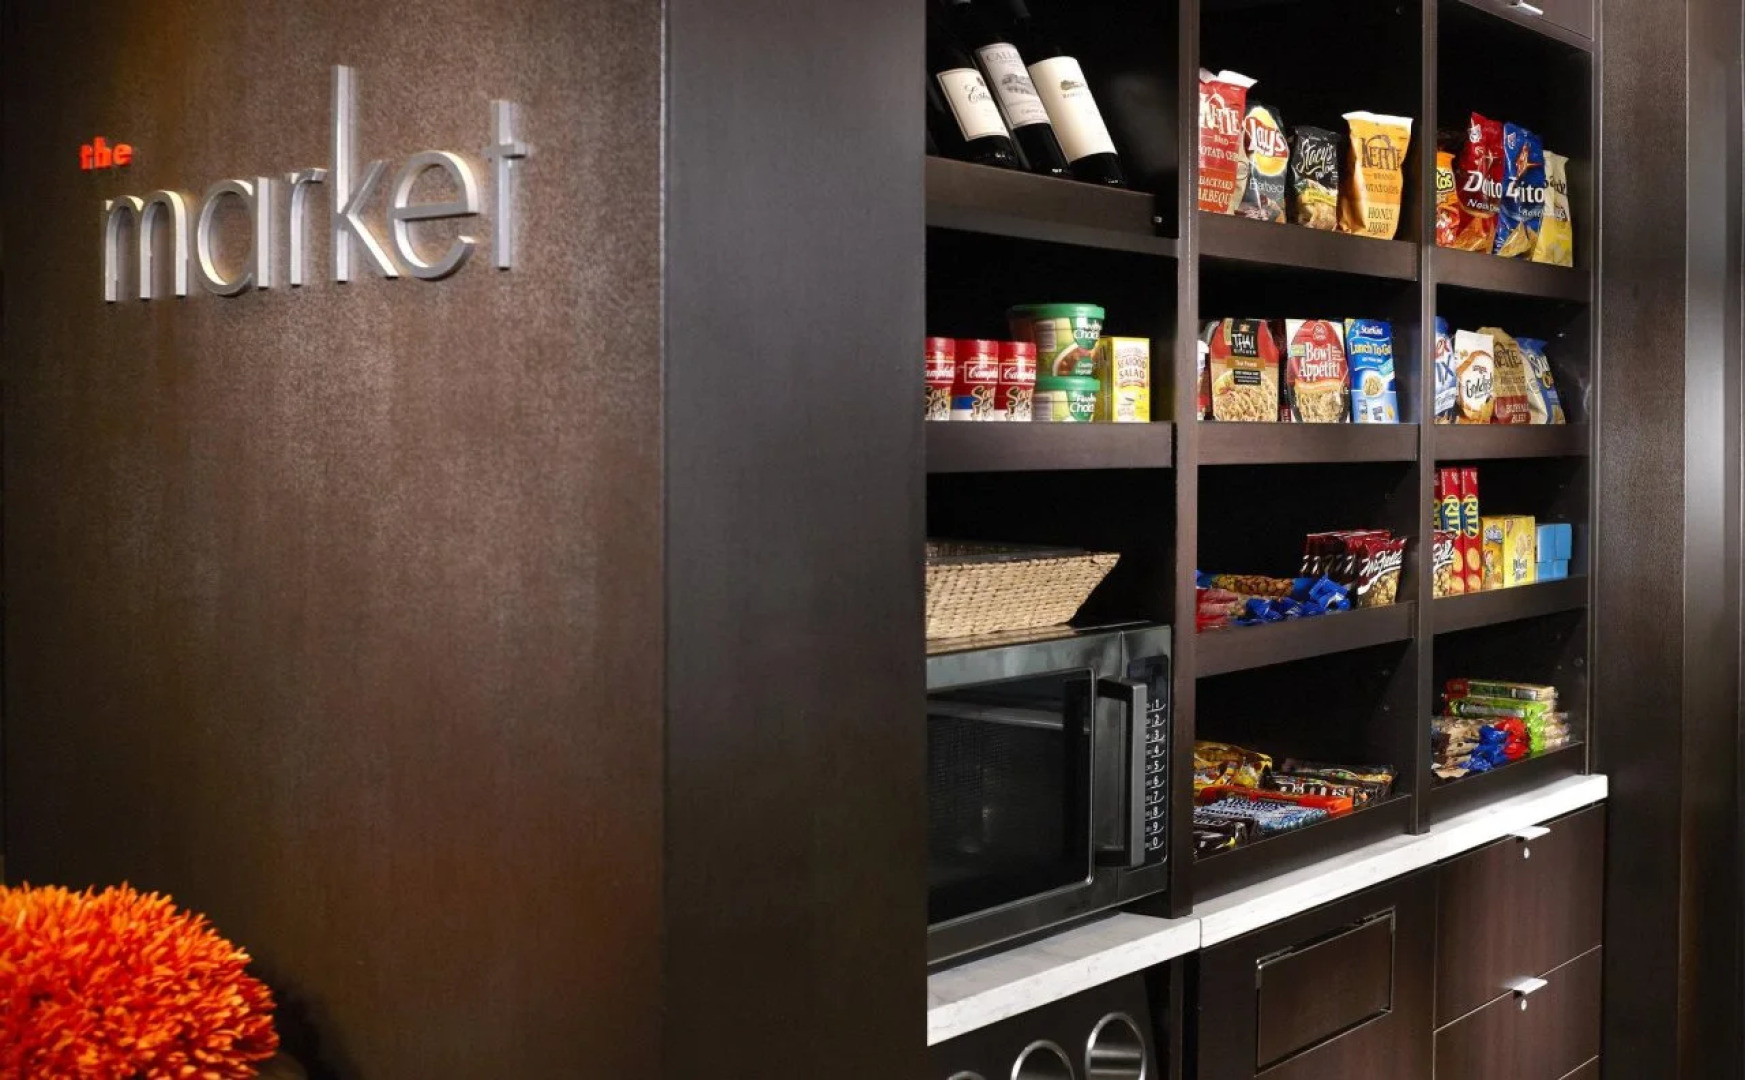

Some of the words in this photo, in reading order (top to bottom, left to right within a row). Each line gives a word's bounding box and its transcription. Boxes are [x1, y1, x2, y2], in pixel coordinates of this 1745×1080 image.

[79, 136, 134, 170] the
[104, 65, 529, 302] market
[1368, 206, 1394, 220] HONEY
[1231, 333, 1254, 350] THAI
[1350, 341, 1373, 355] Lunch
[1305, 341, 1332, 361] Bowl
[1119, 370, 1145, 379] SALAD
[1464, 500, 1479, 534] RITZ
